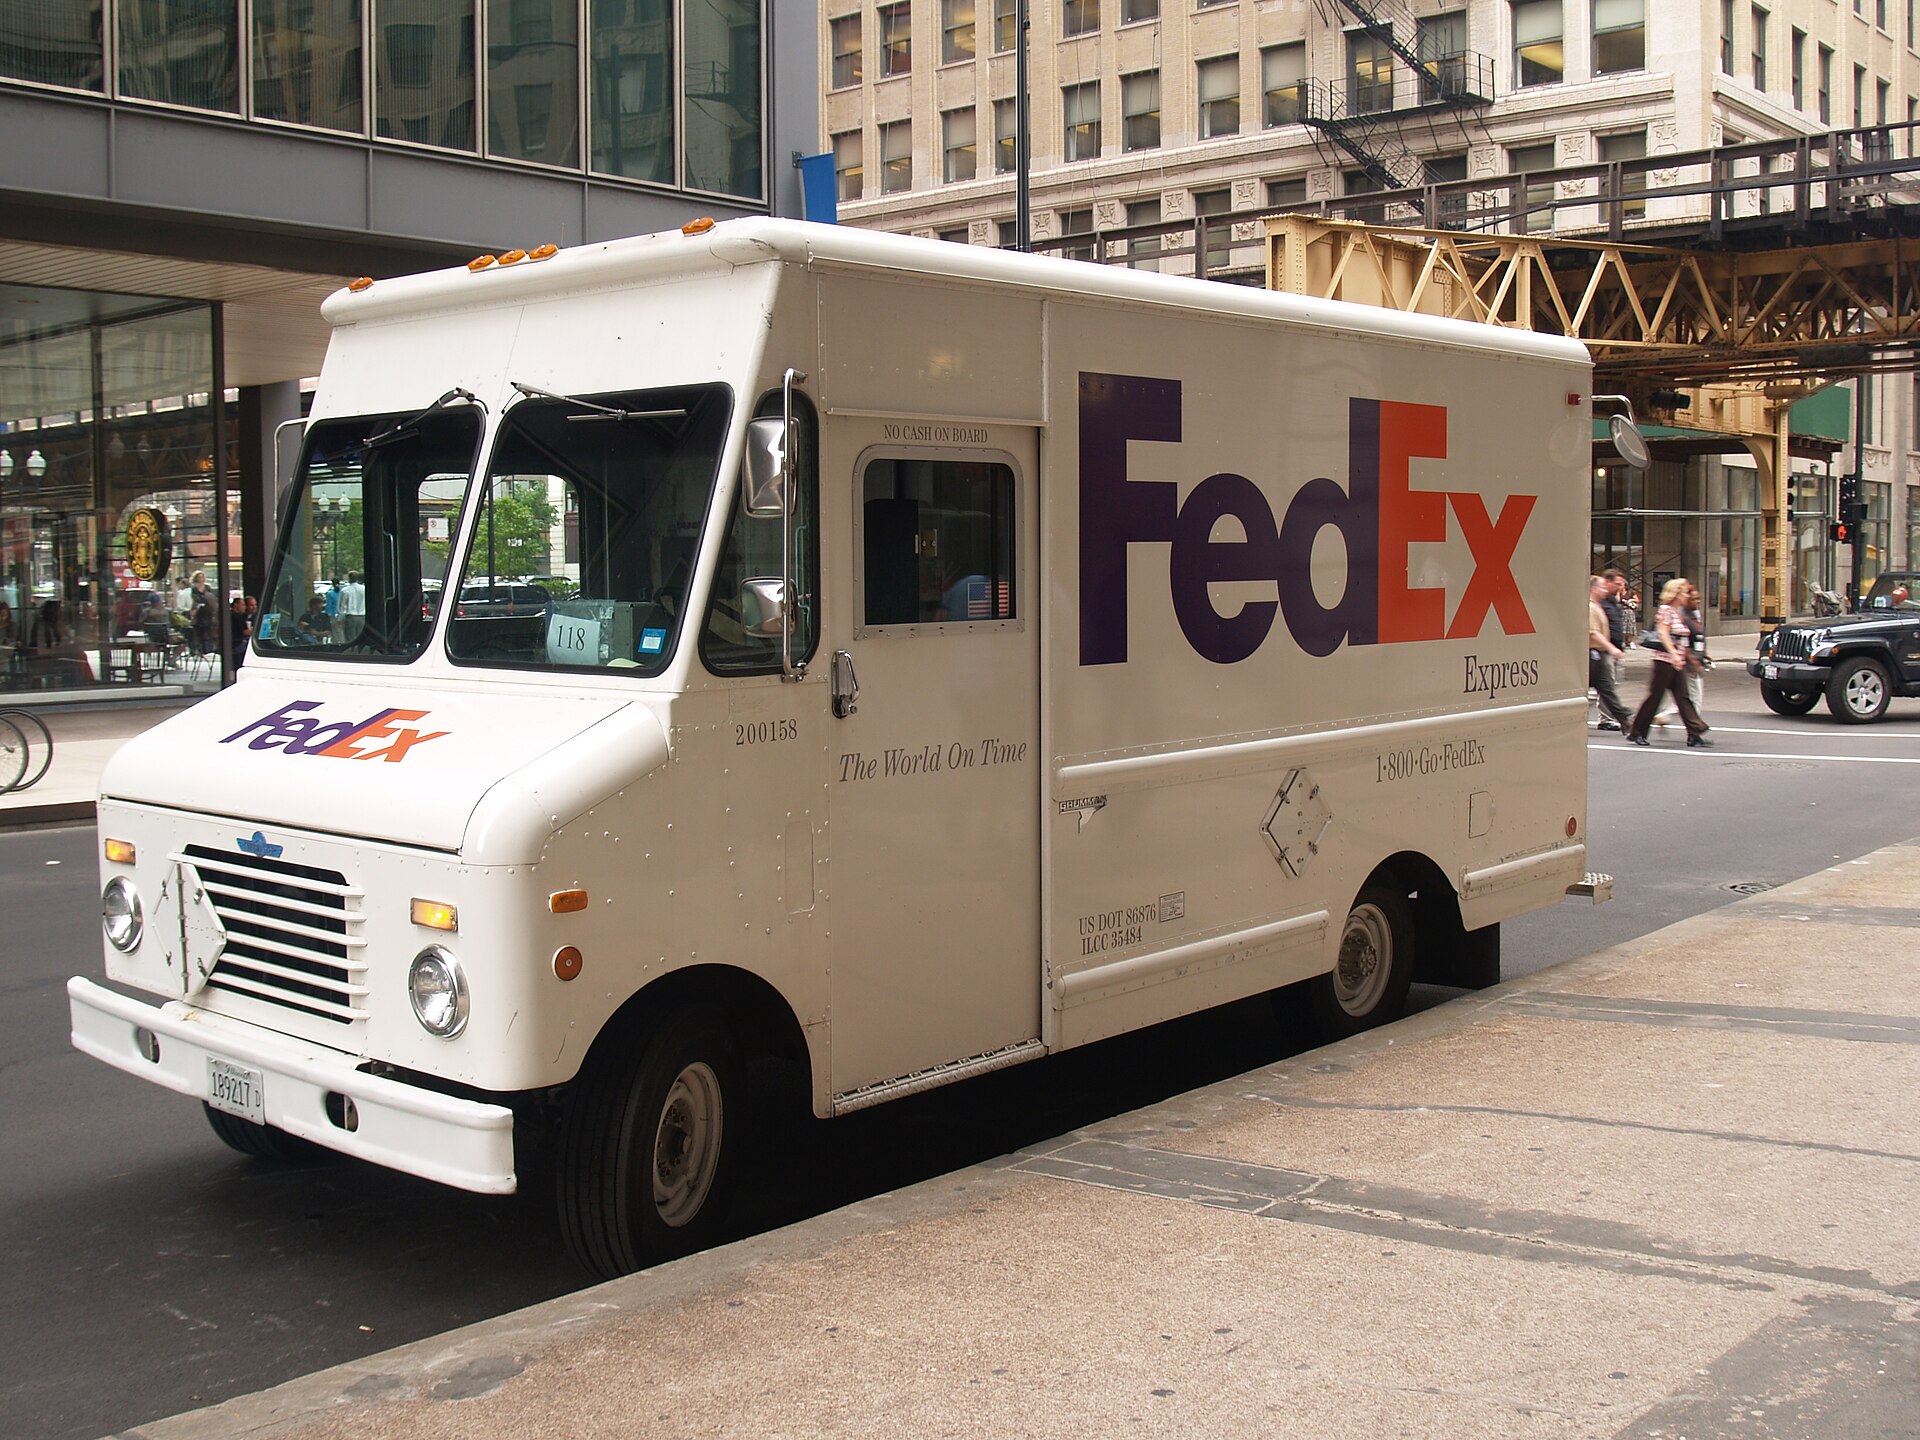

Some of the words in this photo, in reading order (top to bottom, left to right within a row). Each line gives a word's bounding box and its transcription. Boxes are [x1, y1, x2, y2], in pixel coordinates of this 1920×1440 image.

[884, 424, 900, 440] NO
[903, 425, 932, 441] CASH
[934, 427, 950, 442] ON
[952, 428, 988, 443] BOARD
[1078, 370, 1539, 667] FedEx
[556, 624, 586, 651] 118
[1463, 655, 1539, 699] Express
[217, 700, 453, 763] FedEx
[735, 718, 797, 745] 200158
[839, 752, 878, 782] The
[884, 744, 943, 778] World
[948, 742, 975, 770] On
[981, 738, 1027, 766] Time
[1079, 915, 1095, 936] US
[1099, 910, 1124, 932] DOT
[1125, 903, 1156, 926] 86876
[1081, 933, 1108, 955] ILCC
[1111, 925, 1142, 949] 35484
[212, 1071, 250, 1108] 189217
